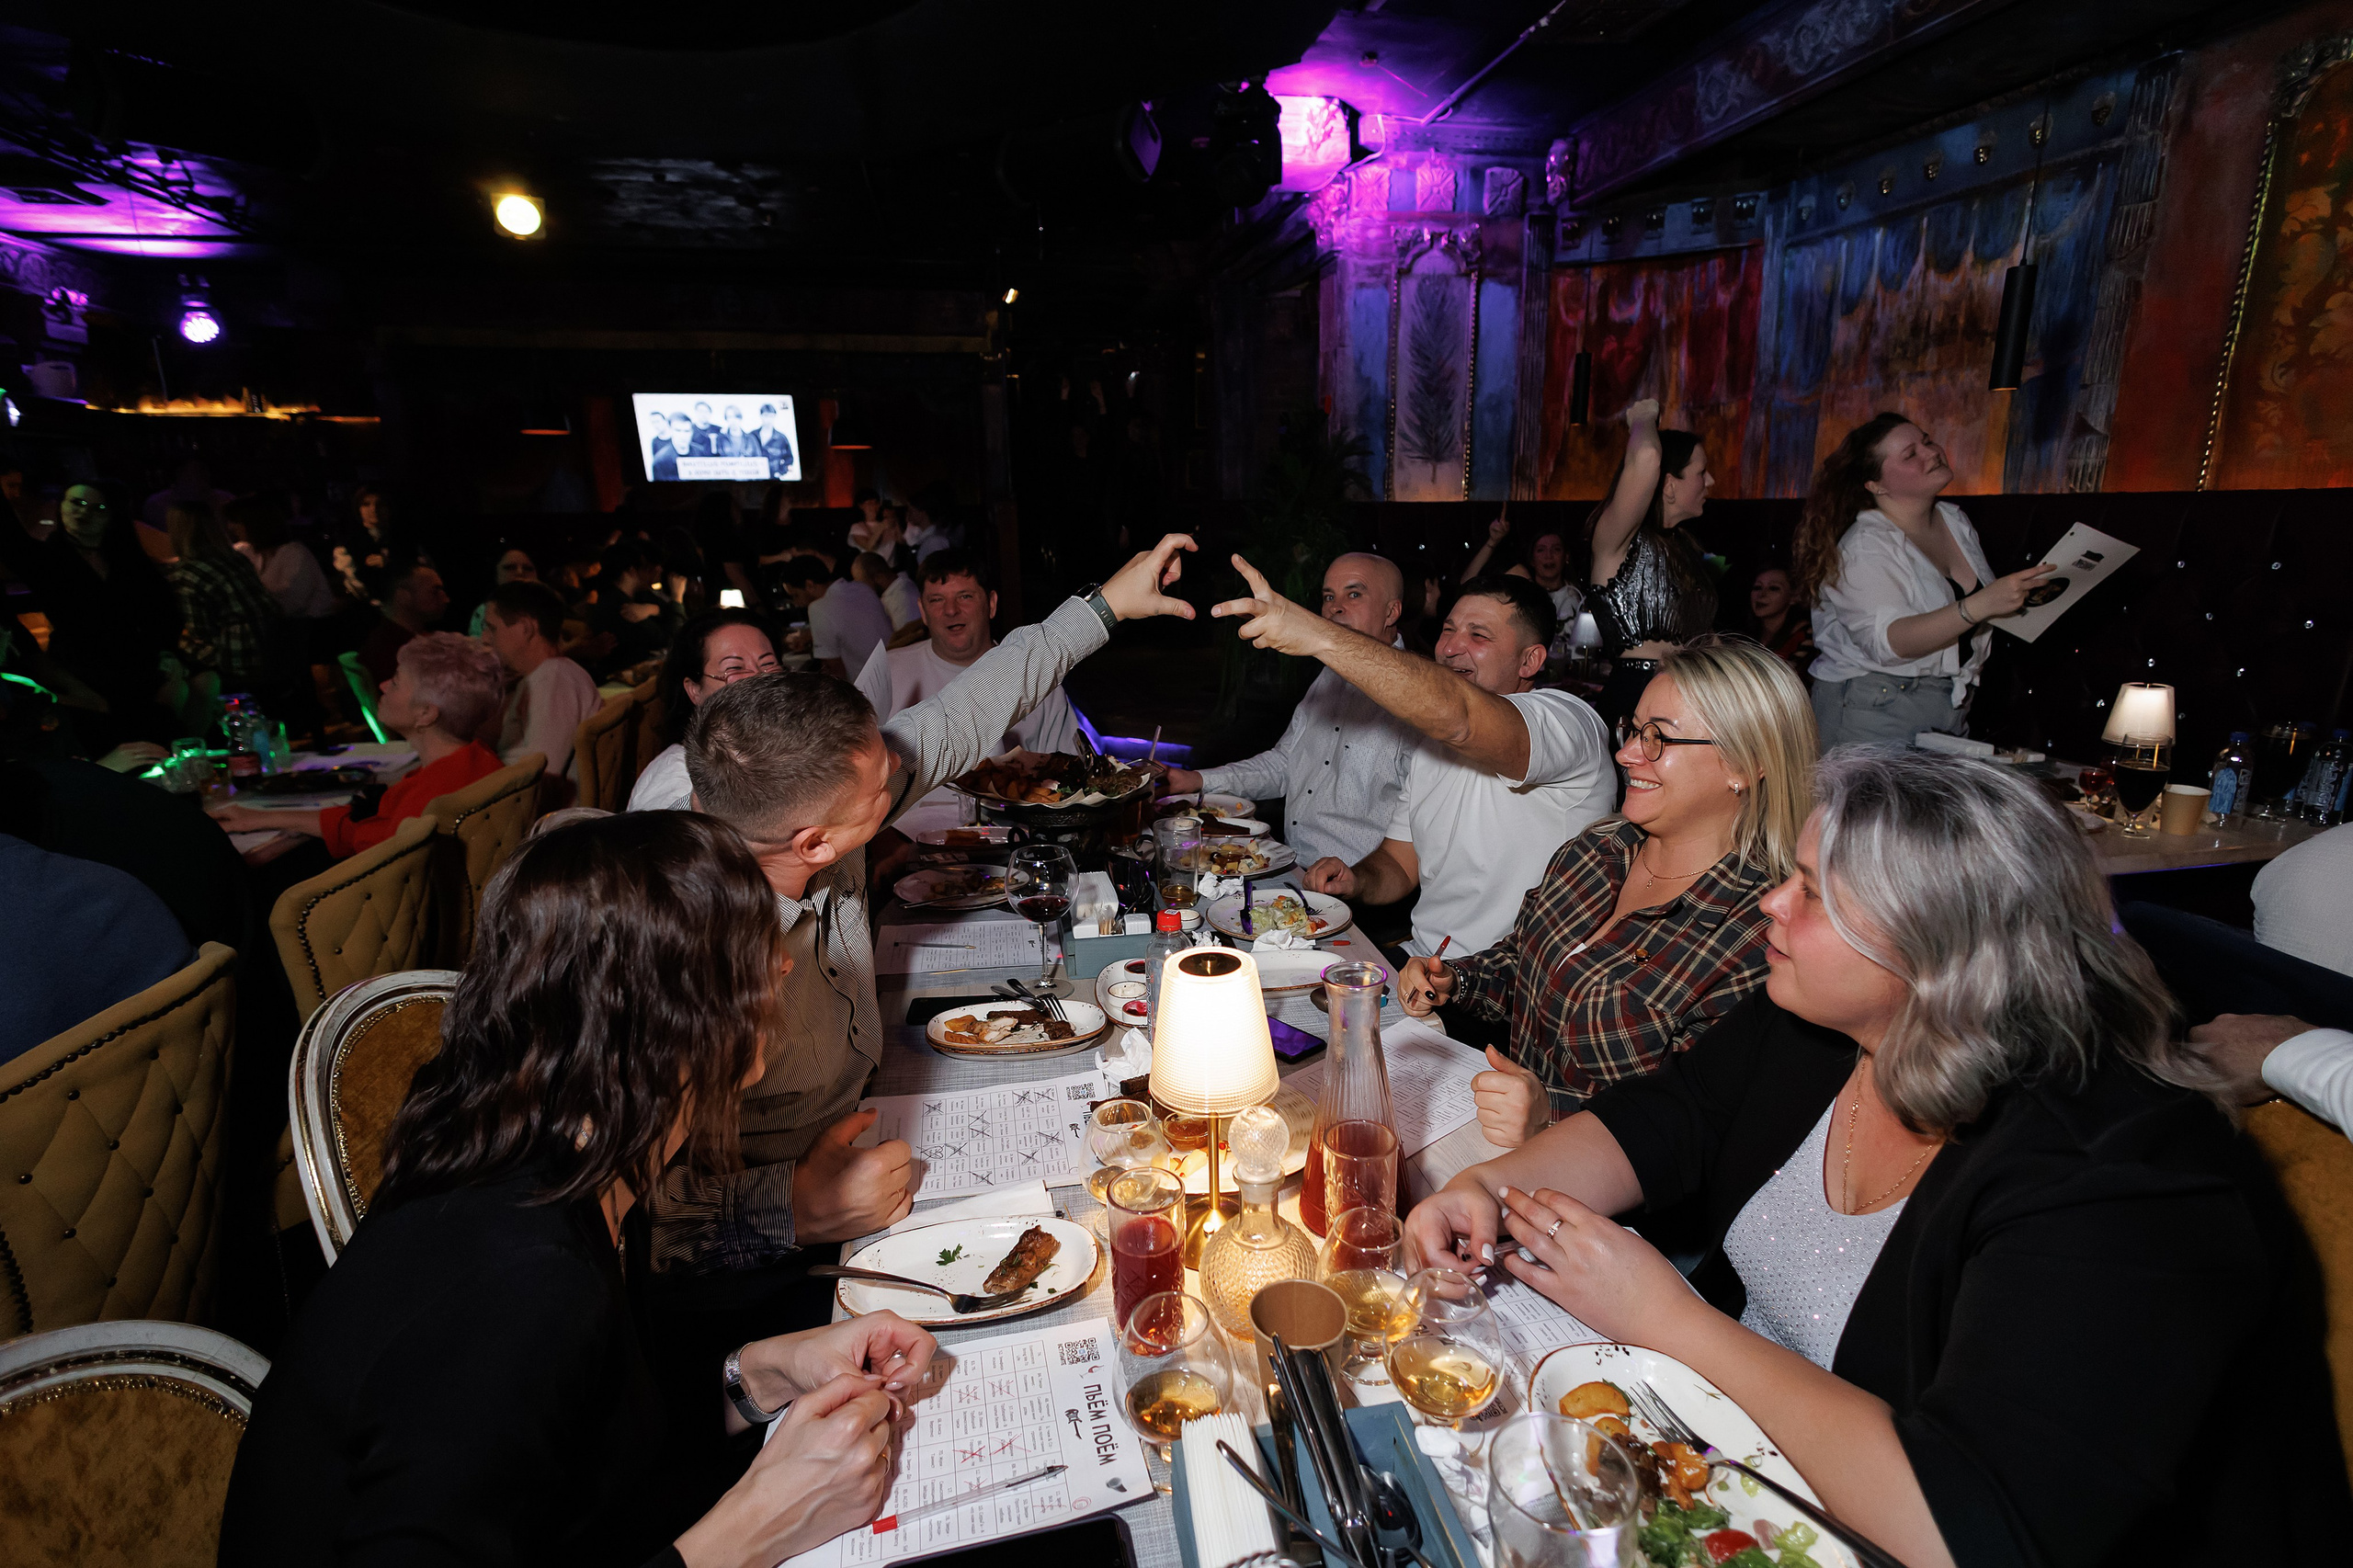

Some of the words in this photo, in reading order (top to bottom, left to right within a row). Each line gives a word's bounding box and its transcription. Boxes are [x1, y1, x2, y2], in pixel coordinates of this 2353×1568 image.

[1057, 1343, 1066, 1366] ВСТУПАЙТЕ
[1084, 1383, 1108, 1421] ПЬЁМ
[1092, 1422, 1119, 1466] ПОЁМ
